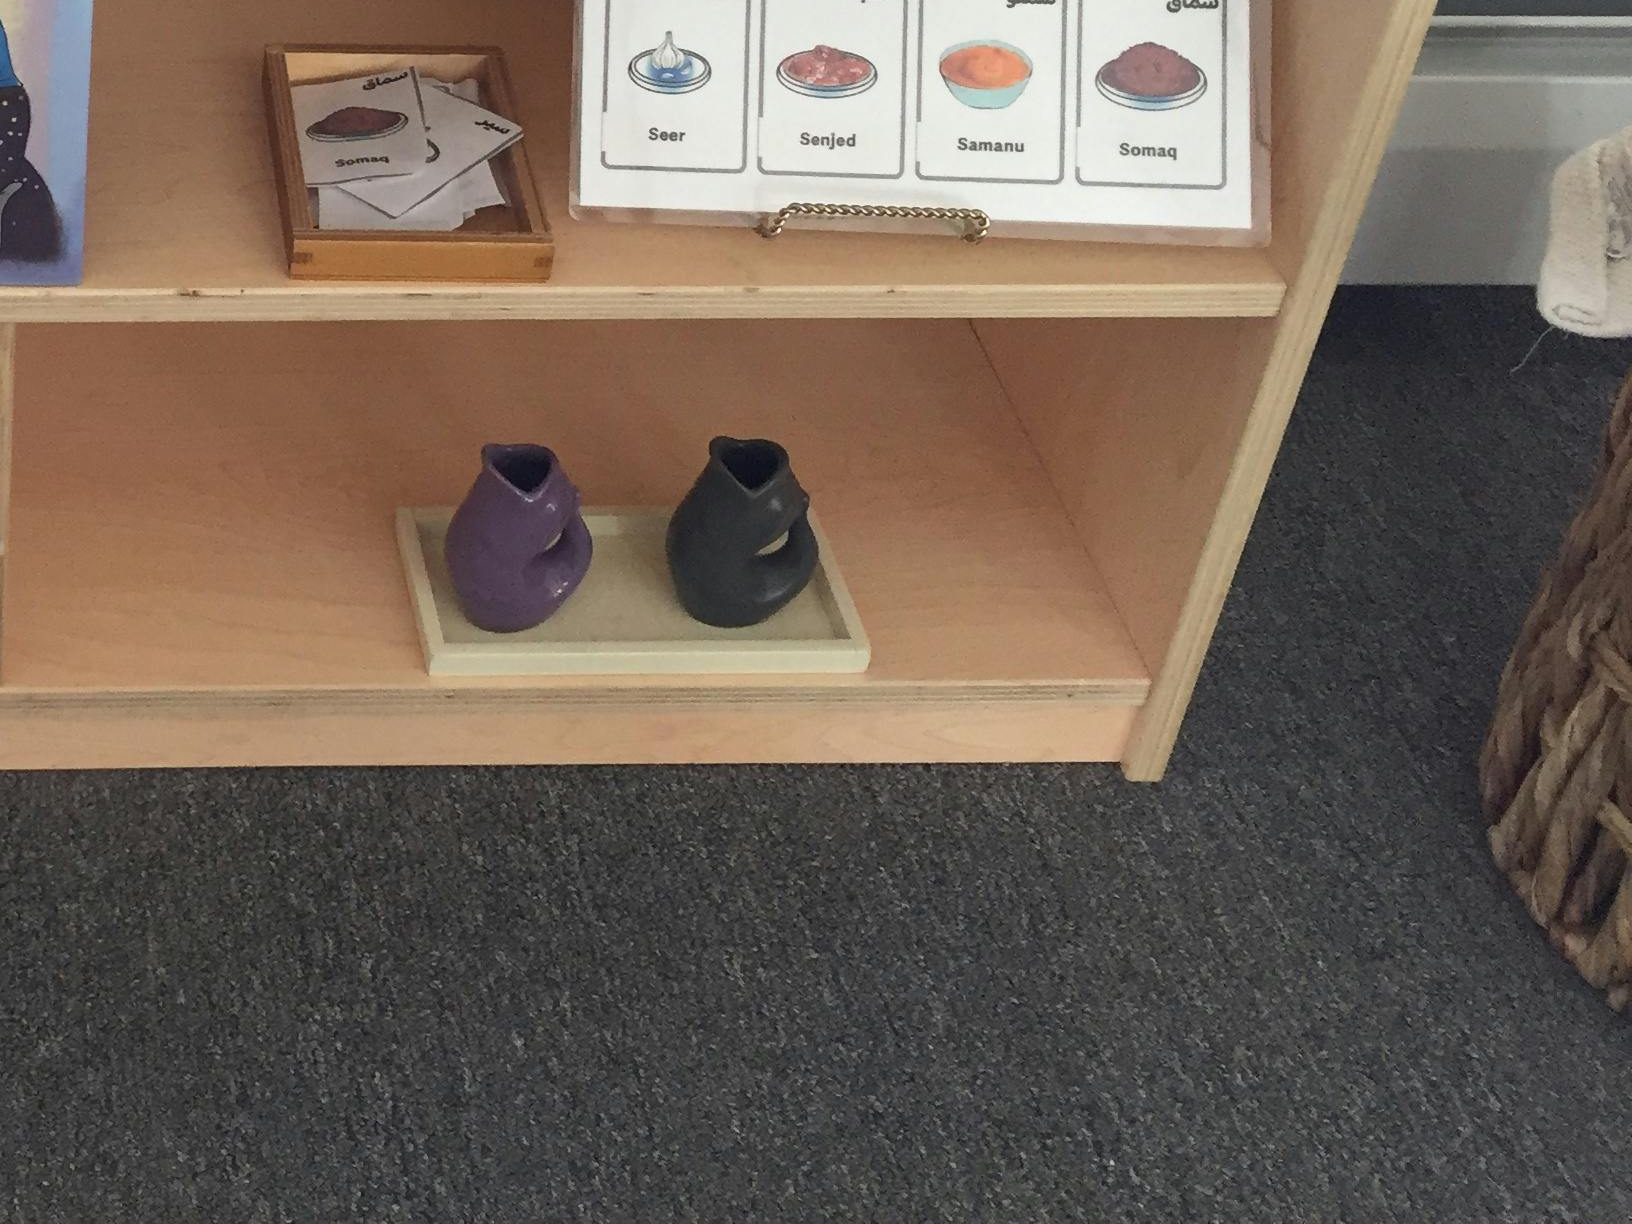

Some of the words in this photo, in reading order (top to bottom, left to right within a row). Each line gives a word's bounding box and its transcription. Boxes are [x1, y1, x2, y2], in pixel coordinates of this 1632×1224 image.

[648, 128, 685, 142] Seer
[799, 132, 856, 150] Senjed
[957, 137, 1025, 153] Samanu
[1118, 143, 1178, 161] Somaq
[335, 155, 389, 169] Somaq
